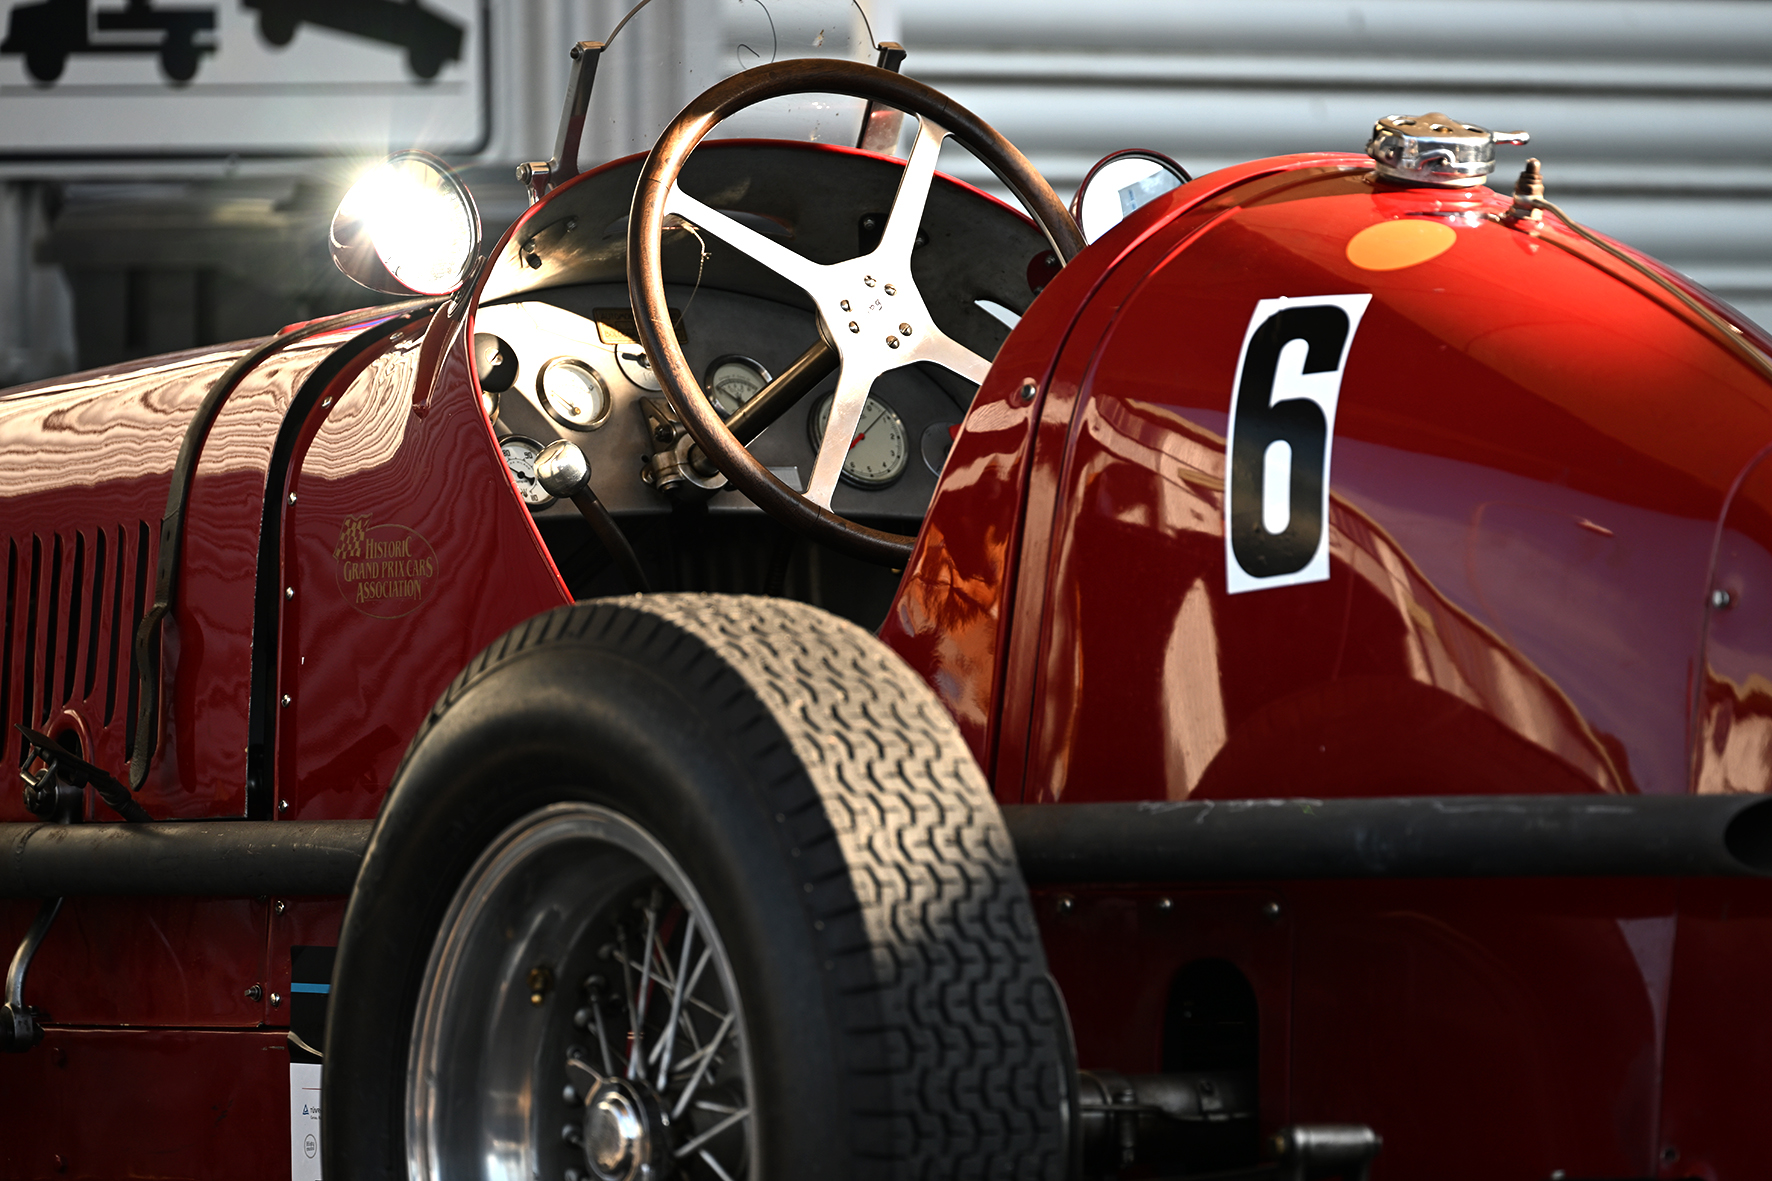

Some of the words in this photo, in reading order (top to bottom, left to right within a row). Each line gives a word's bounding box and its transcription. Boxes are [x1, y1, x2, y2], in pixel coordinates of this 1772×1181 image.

[1230, 304, 1351, 578] 6
[365, 536, 413, 559] HISTORIC
[343, 561, 380, 582] GRAND
[381, 560, 405, 578] PRIX
[406, 556, 434, 578] CARS
[355, 579, 422, 604] ASSOCIATION
